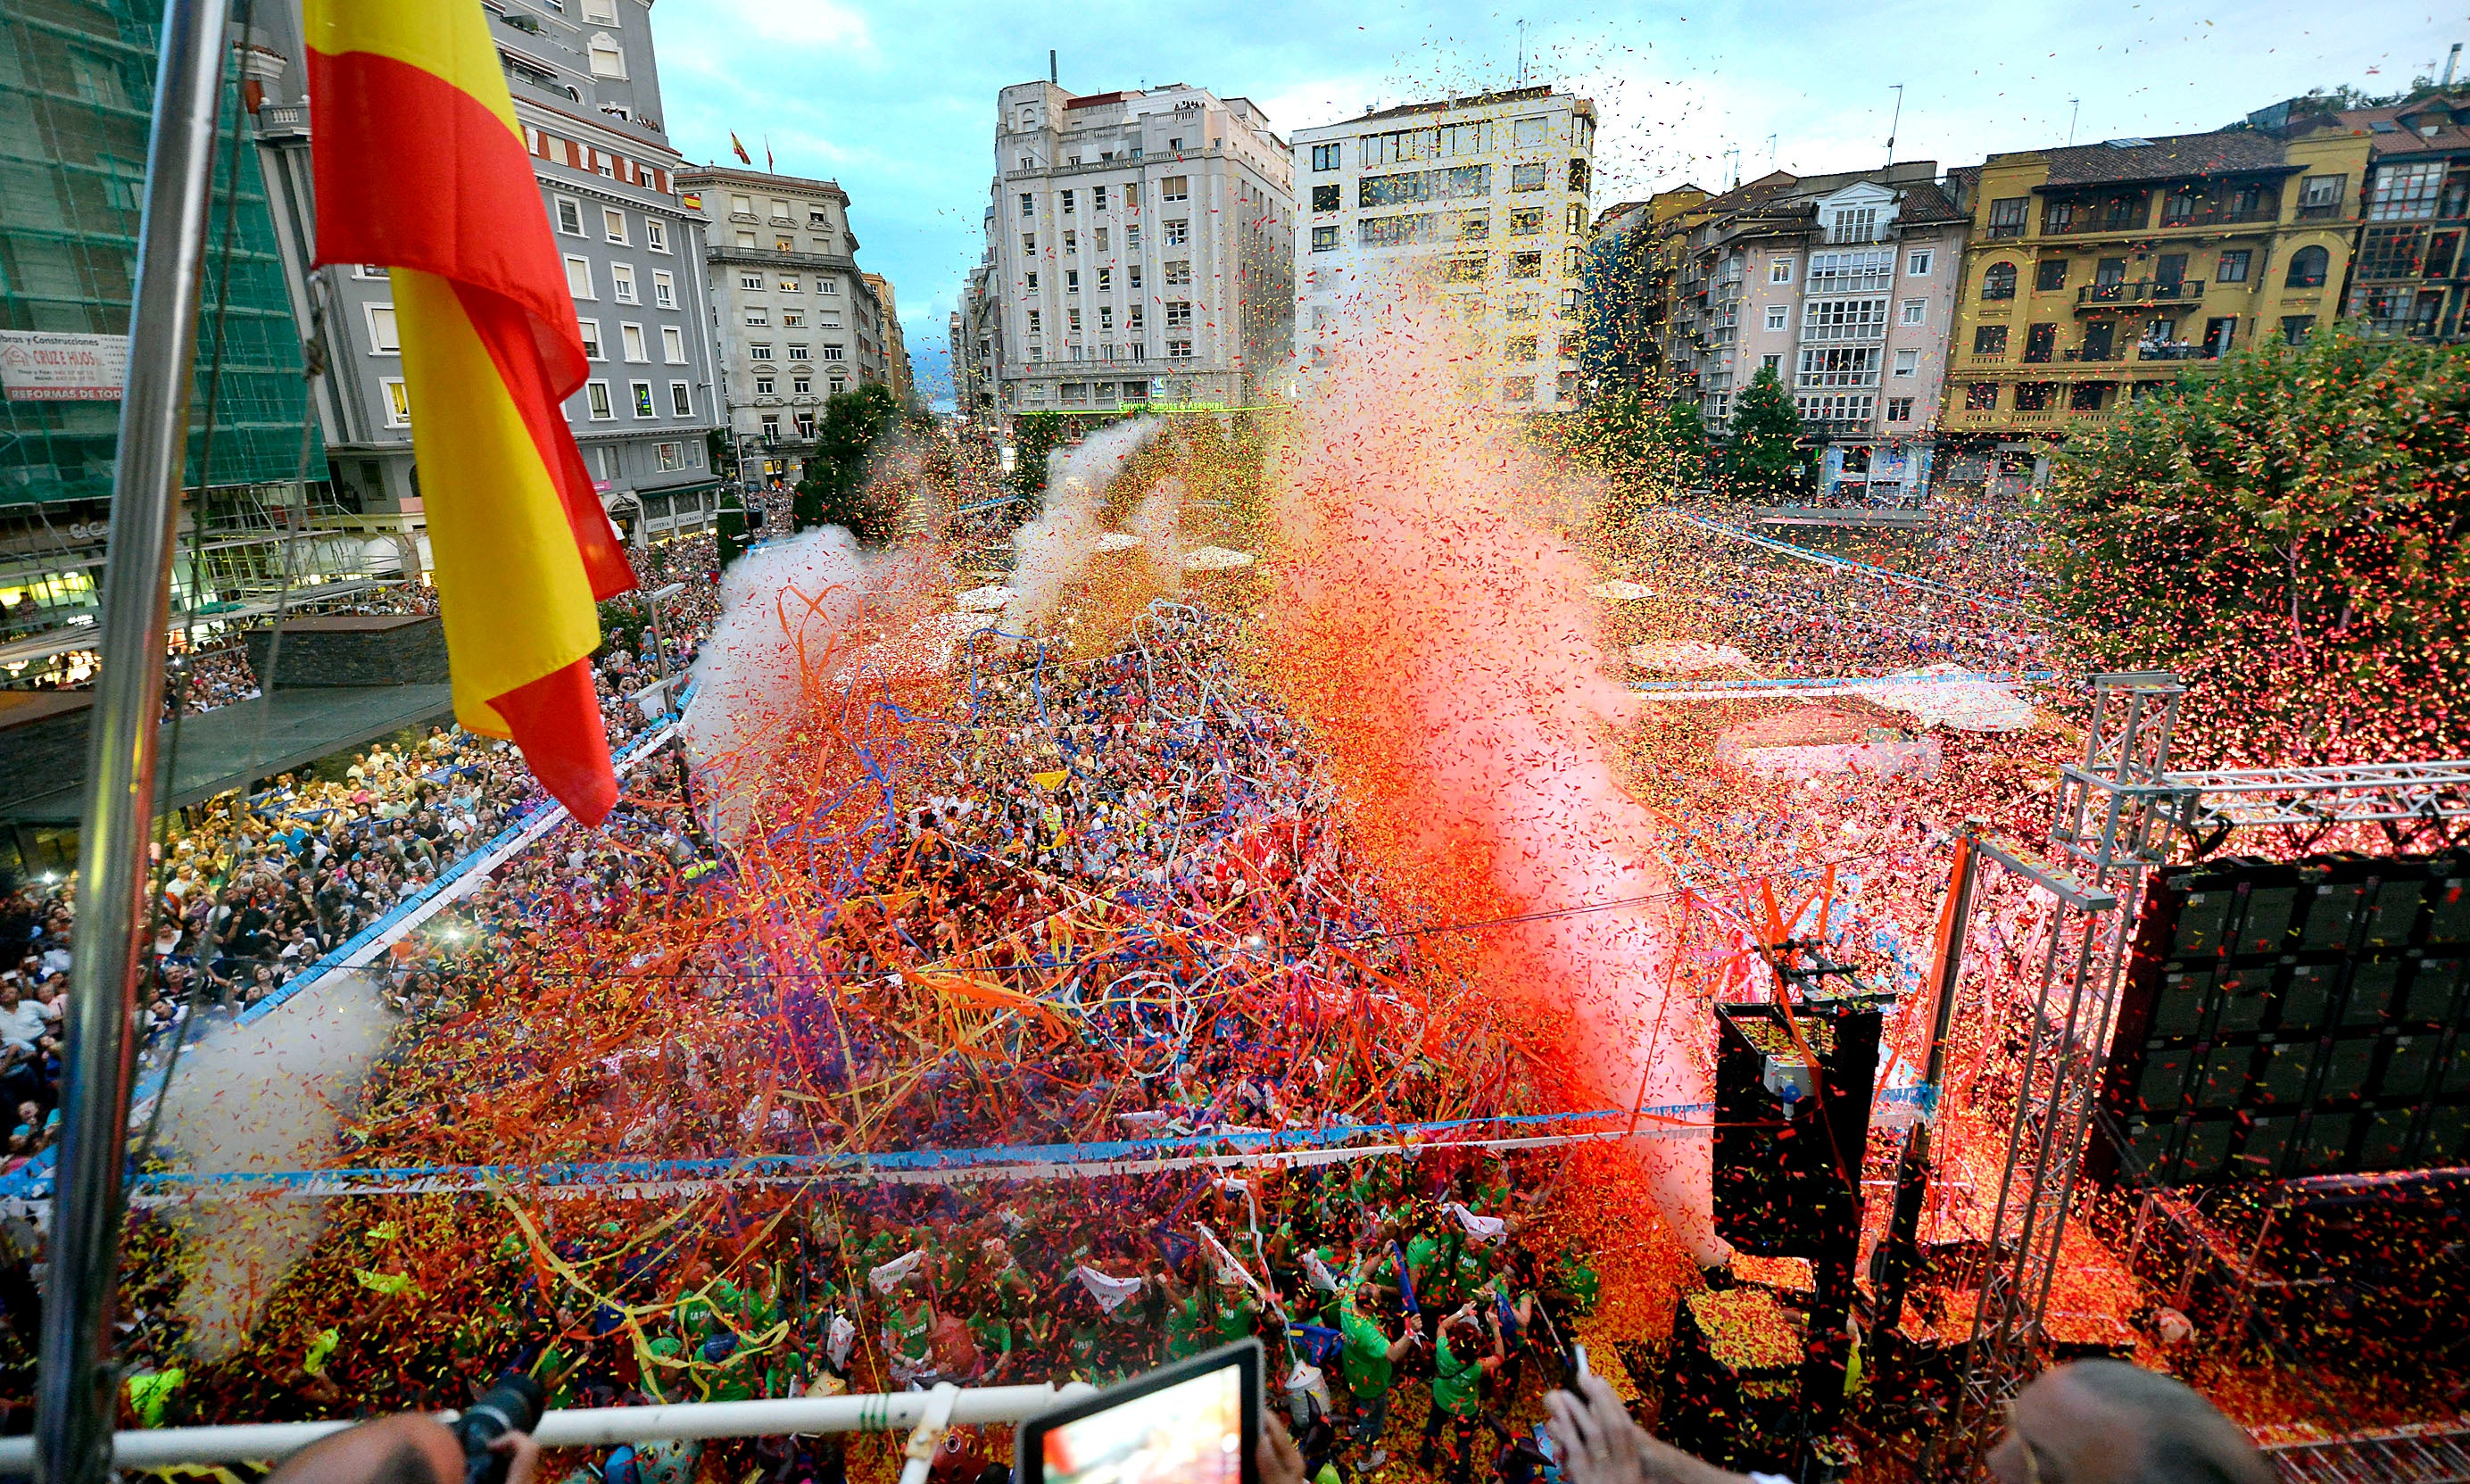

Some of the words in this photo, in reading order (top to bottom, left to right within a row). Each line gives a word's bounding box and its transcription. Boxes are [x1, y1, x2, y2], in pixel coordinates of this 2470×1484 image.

[33, 336, 99, 346] Construcciones
[12, 389, 76, 399] REFORMAS
[79, 389, 94, 399] DE
[1187, 400, 1224, 410] Asesores
